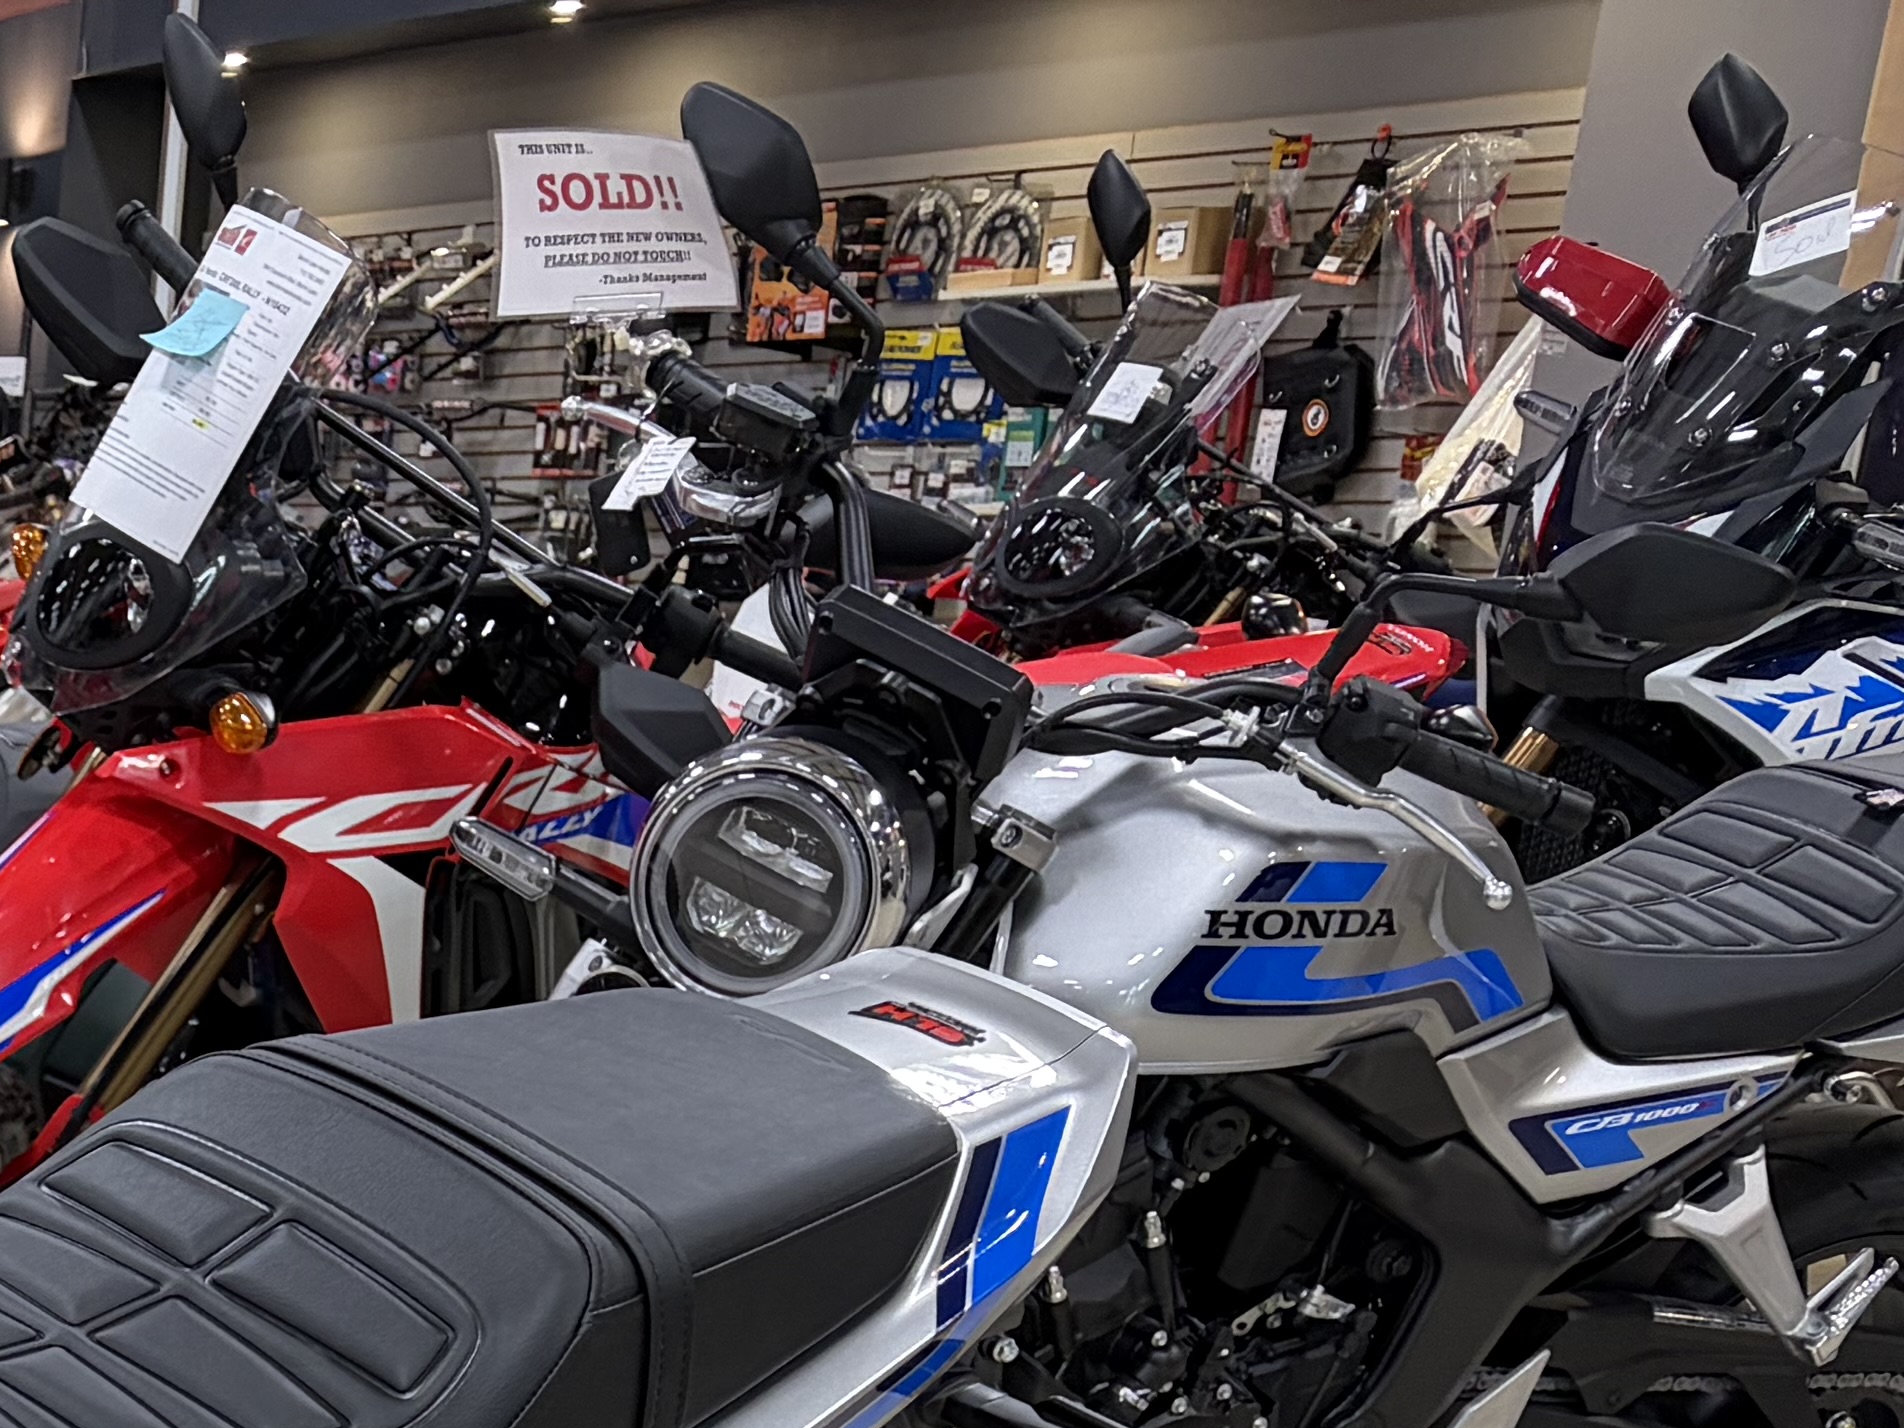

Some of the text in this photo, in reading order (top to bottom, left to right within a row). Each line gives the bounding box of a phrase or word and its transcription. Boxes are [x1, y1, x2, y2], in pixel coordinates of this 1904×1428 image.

[518, 143, 544, 155] THIS
[546, 143, 573, 155] UNIT
[537, 172, 683, 213] SOLD!!
[524, 231, 707, 248] TO RESPECT THE NEW OWNERS,
[544, 249, 692, 267] PLEASE DO NOT TOUCH!!
[642, 272, 707, 285] Management
[1201, 907, 1397, 940] HONDA
